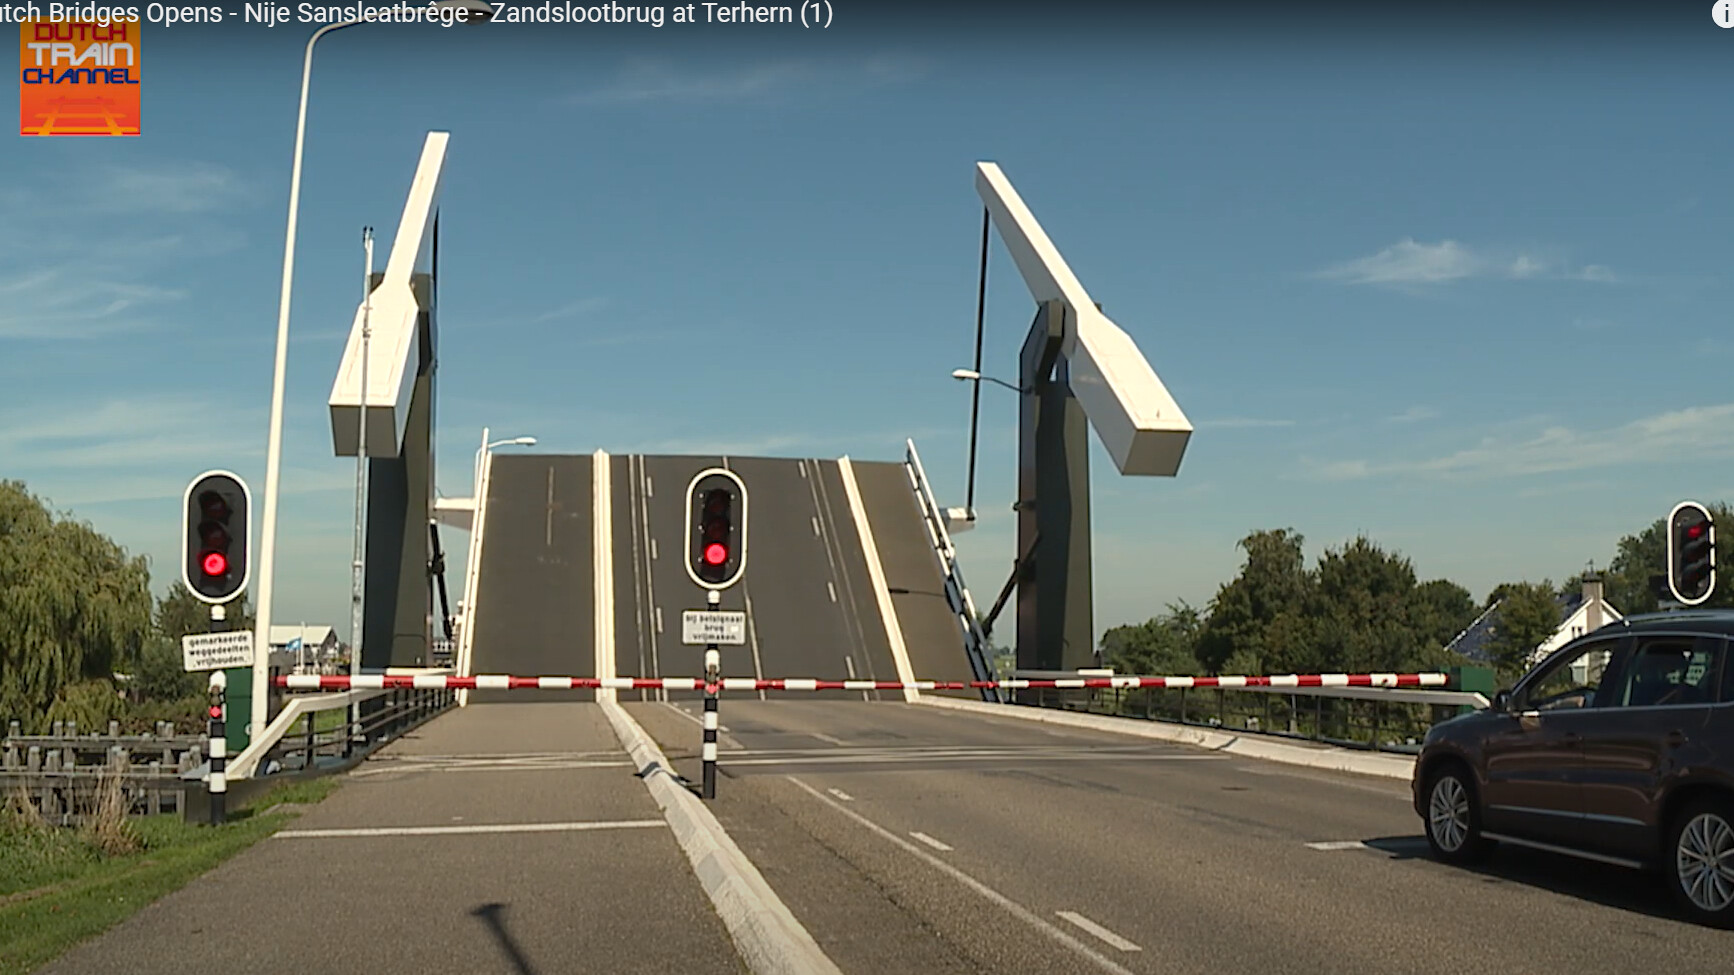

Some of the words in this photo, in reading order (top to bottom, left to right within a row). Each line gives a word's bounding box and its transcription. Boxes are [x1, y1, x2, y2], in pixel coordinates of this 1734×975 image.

[704, 624, 724, 632] brug
[188, 634, 247, 648] gemarkeerde
[188, 645, 250, 657] weggedeelten
